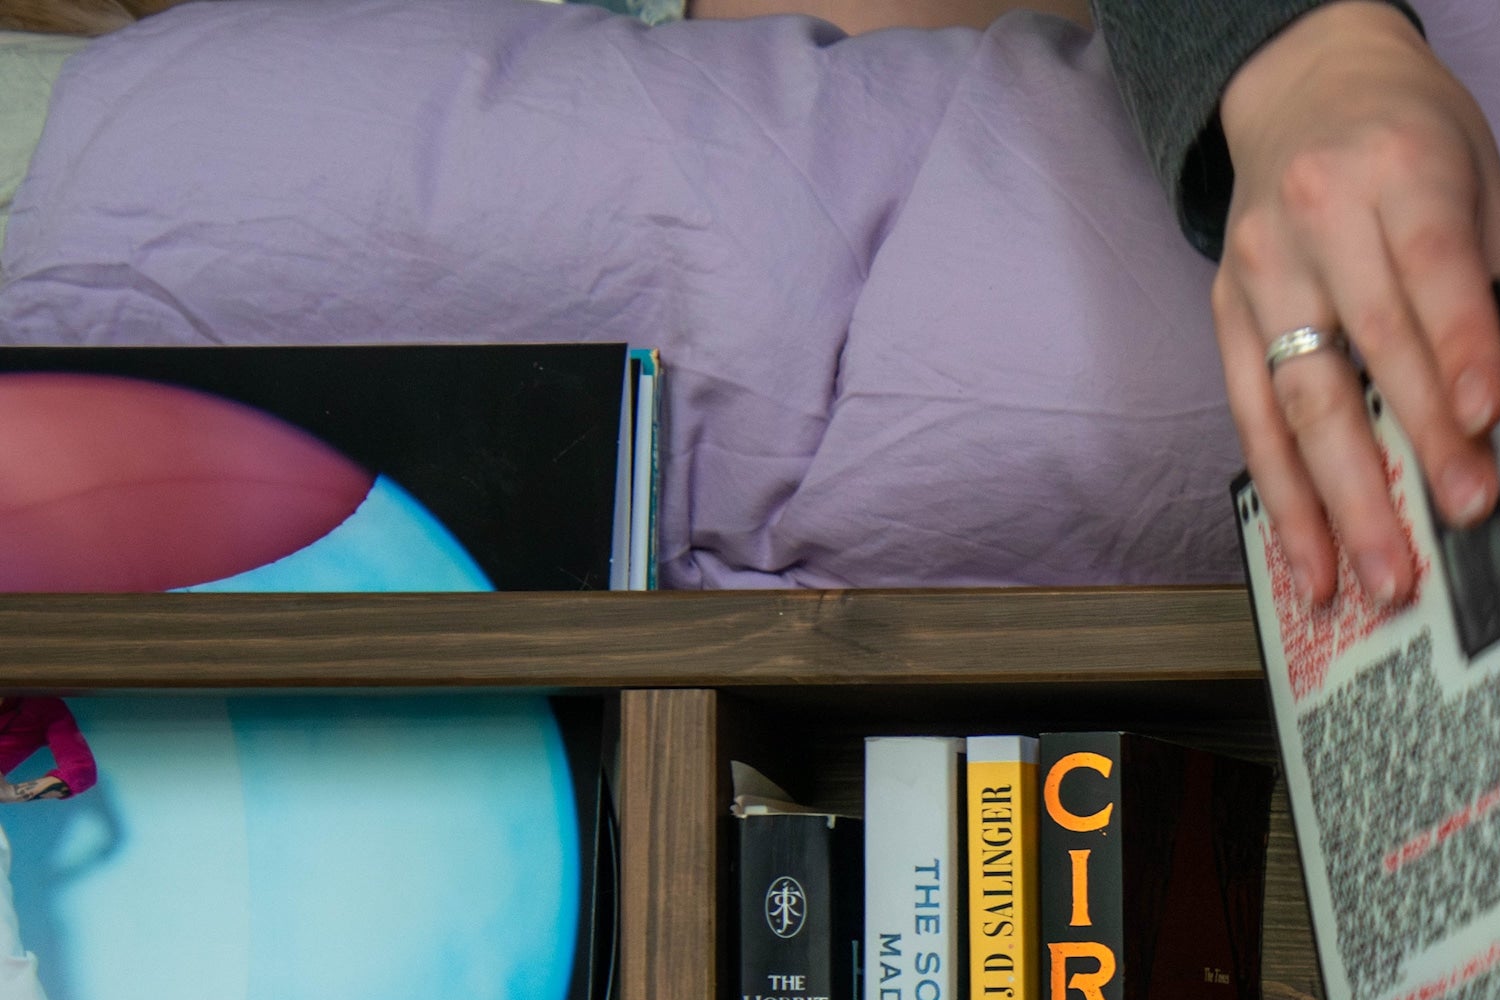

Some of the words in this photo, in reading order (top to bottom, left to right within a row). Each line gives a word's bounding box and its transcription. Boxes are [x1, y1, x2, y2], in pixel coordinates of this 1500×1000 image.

[914, 858, 941, 936] THE
[981, 784, 1015, 937] SALINGER
[767, 974, 806, 991] THE
